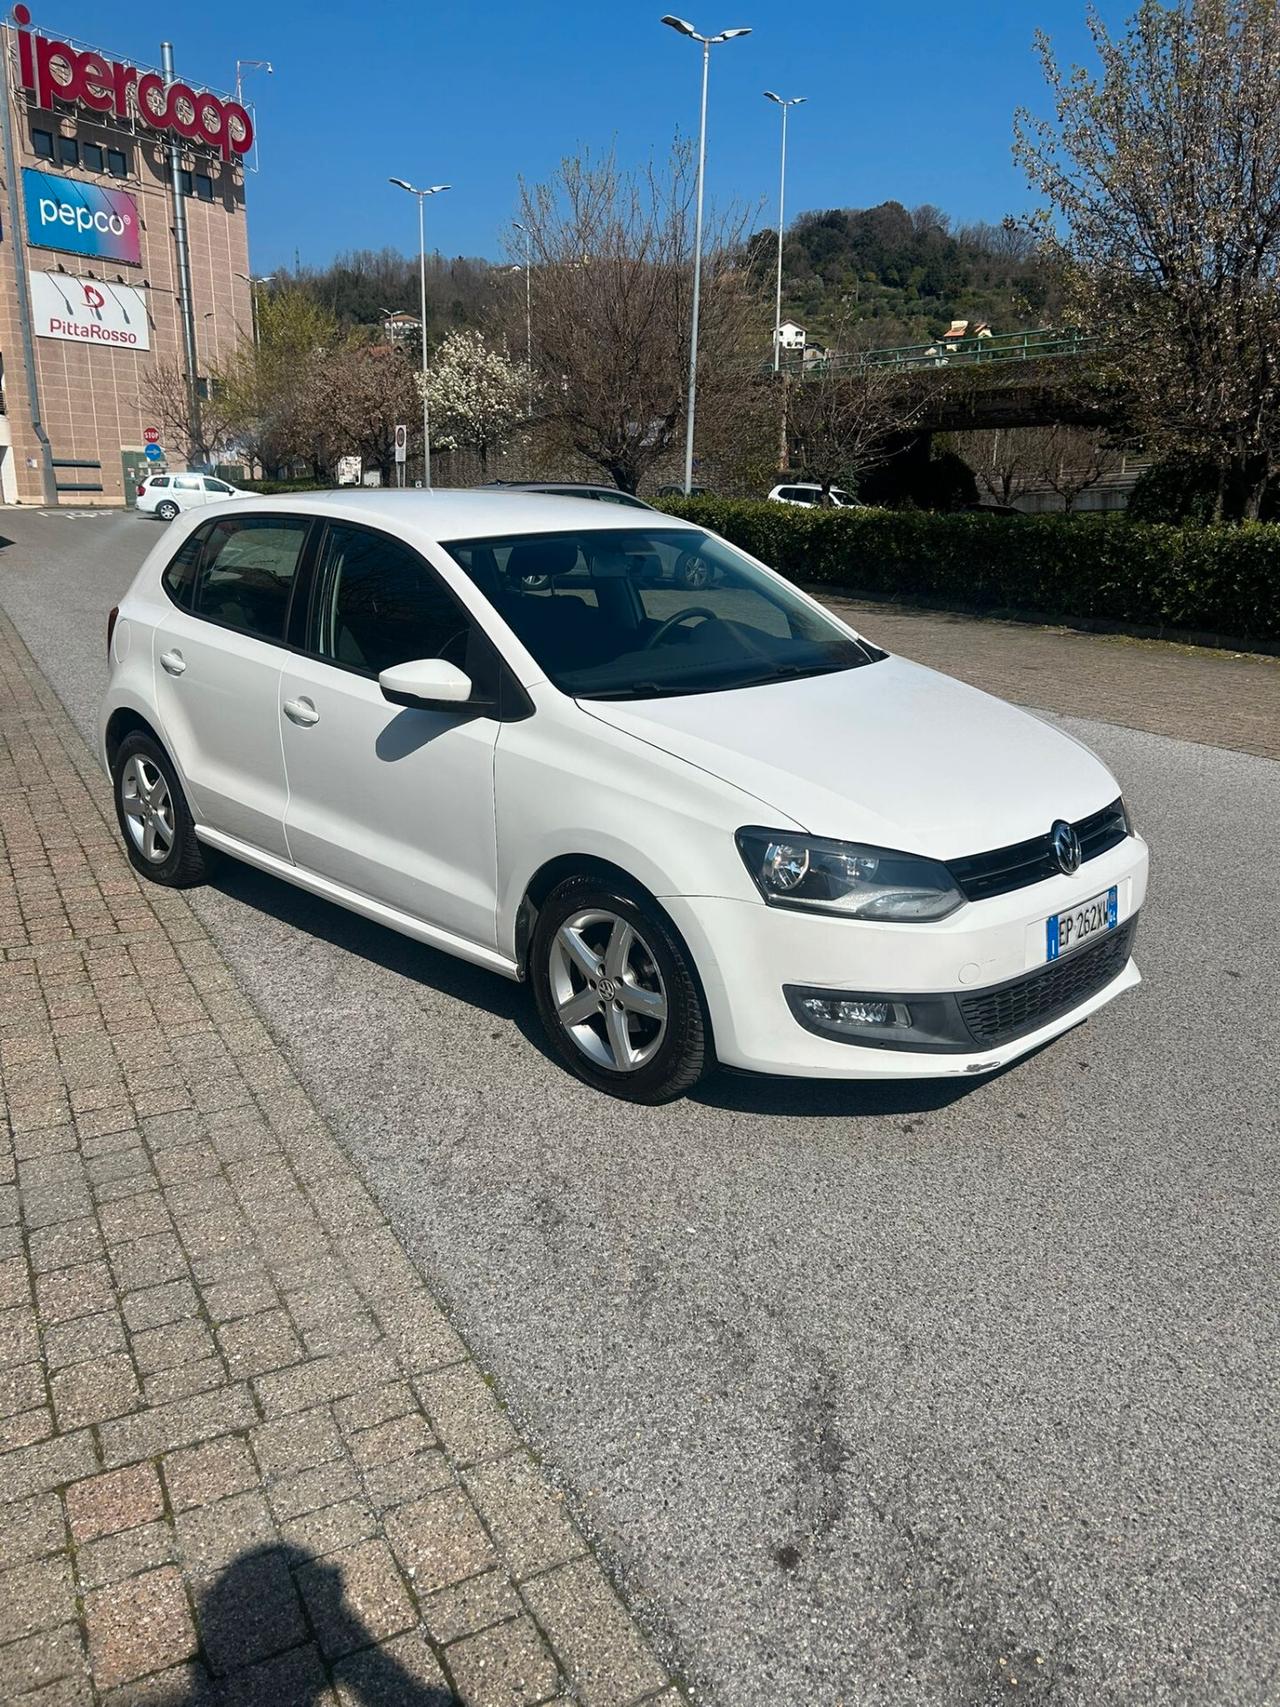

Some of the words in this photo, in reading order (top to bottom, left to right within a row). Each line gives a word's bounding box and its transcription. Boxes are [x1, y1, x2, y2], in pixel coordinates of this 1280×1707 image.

[12, 3, 253, 163] ipercoop
[50, 318, 137, 344] PittaRosso
[143, 431, 159, 439] STOP
[1059, 916, 1073, 947] EP
